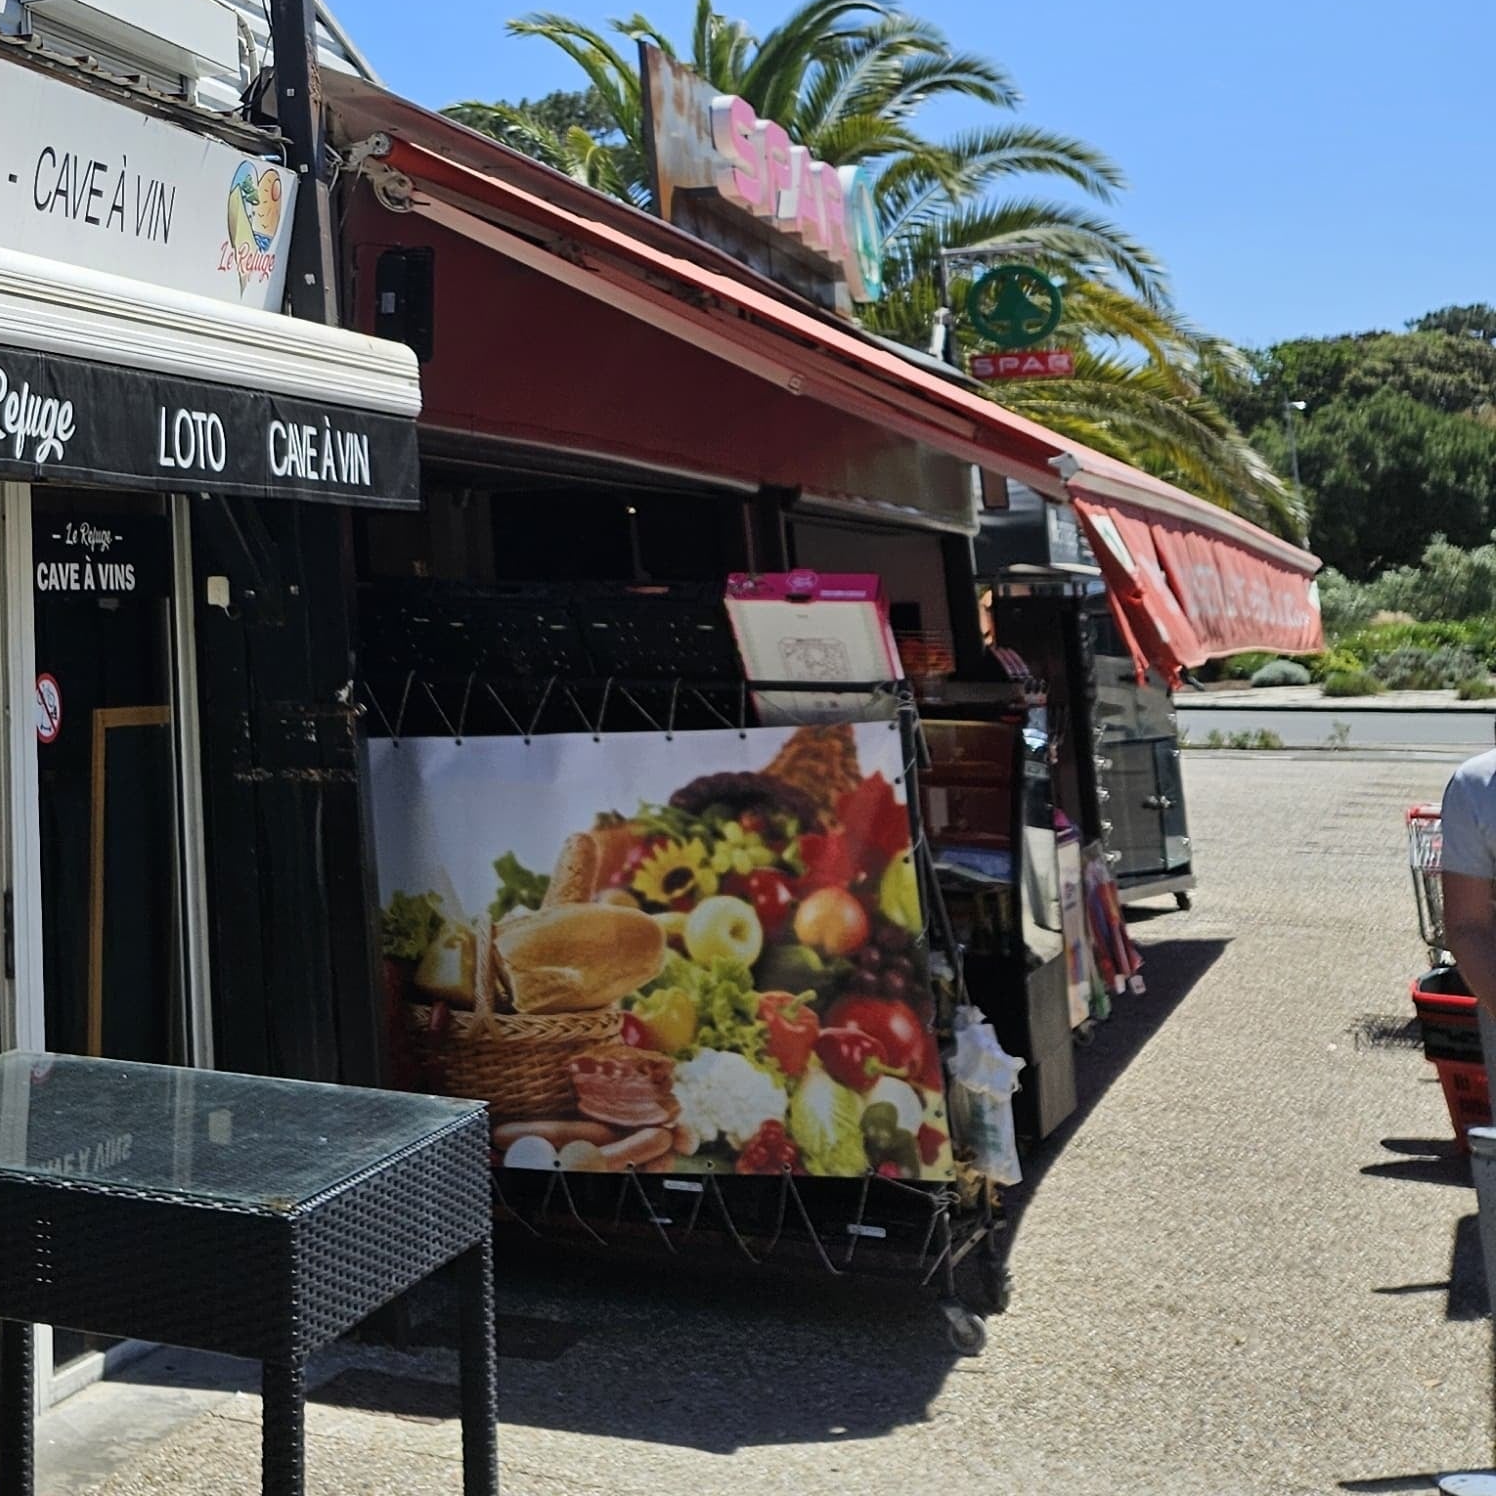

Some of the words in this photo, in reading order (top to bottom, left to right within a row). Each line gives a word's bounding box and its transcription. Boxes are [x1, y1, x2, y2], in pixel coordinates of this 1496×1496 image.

[32, 146, 108, 228] CAVE
[106, 155, 128, 233] À
[135, 171, 177, 245] VIN
[710, 94, 850, 262] SPAR
[217, 241, 234, 272] Le
[973, 353, 1070, 377] SPAR
[158, 406, 227, 472] LOTO
[269, 420, 318, 481] CAVE
[321, 416, 341, 483] À
[339, 431, 371, 487] VIN
[65, 522, 78, 545] Le
[79, 522, 113, 553] Refuge
[37, 562, 81, 591] CAVE
[83, 554, 96, 591] À
[97, 563, 136, 592] VINS
